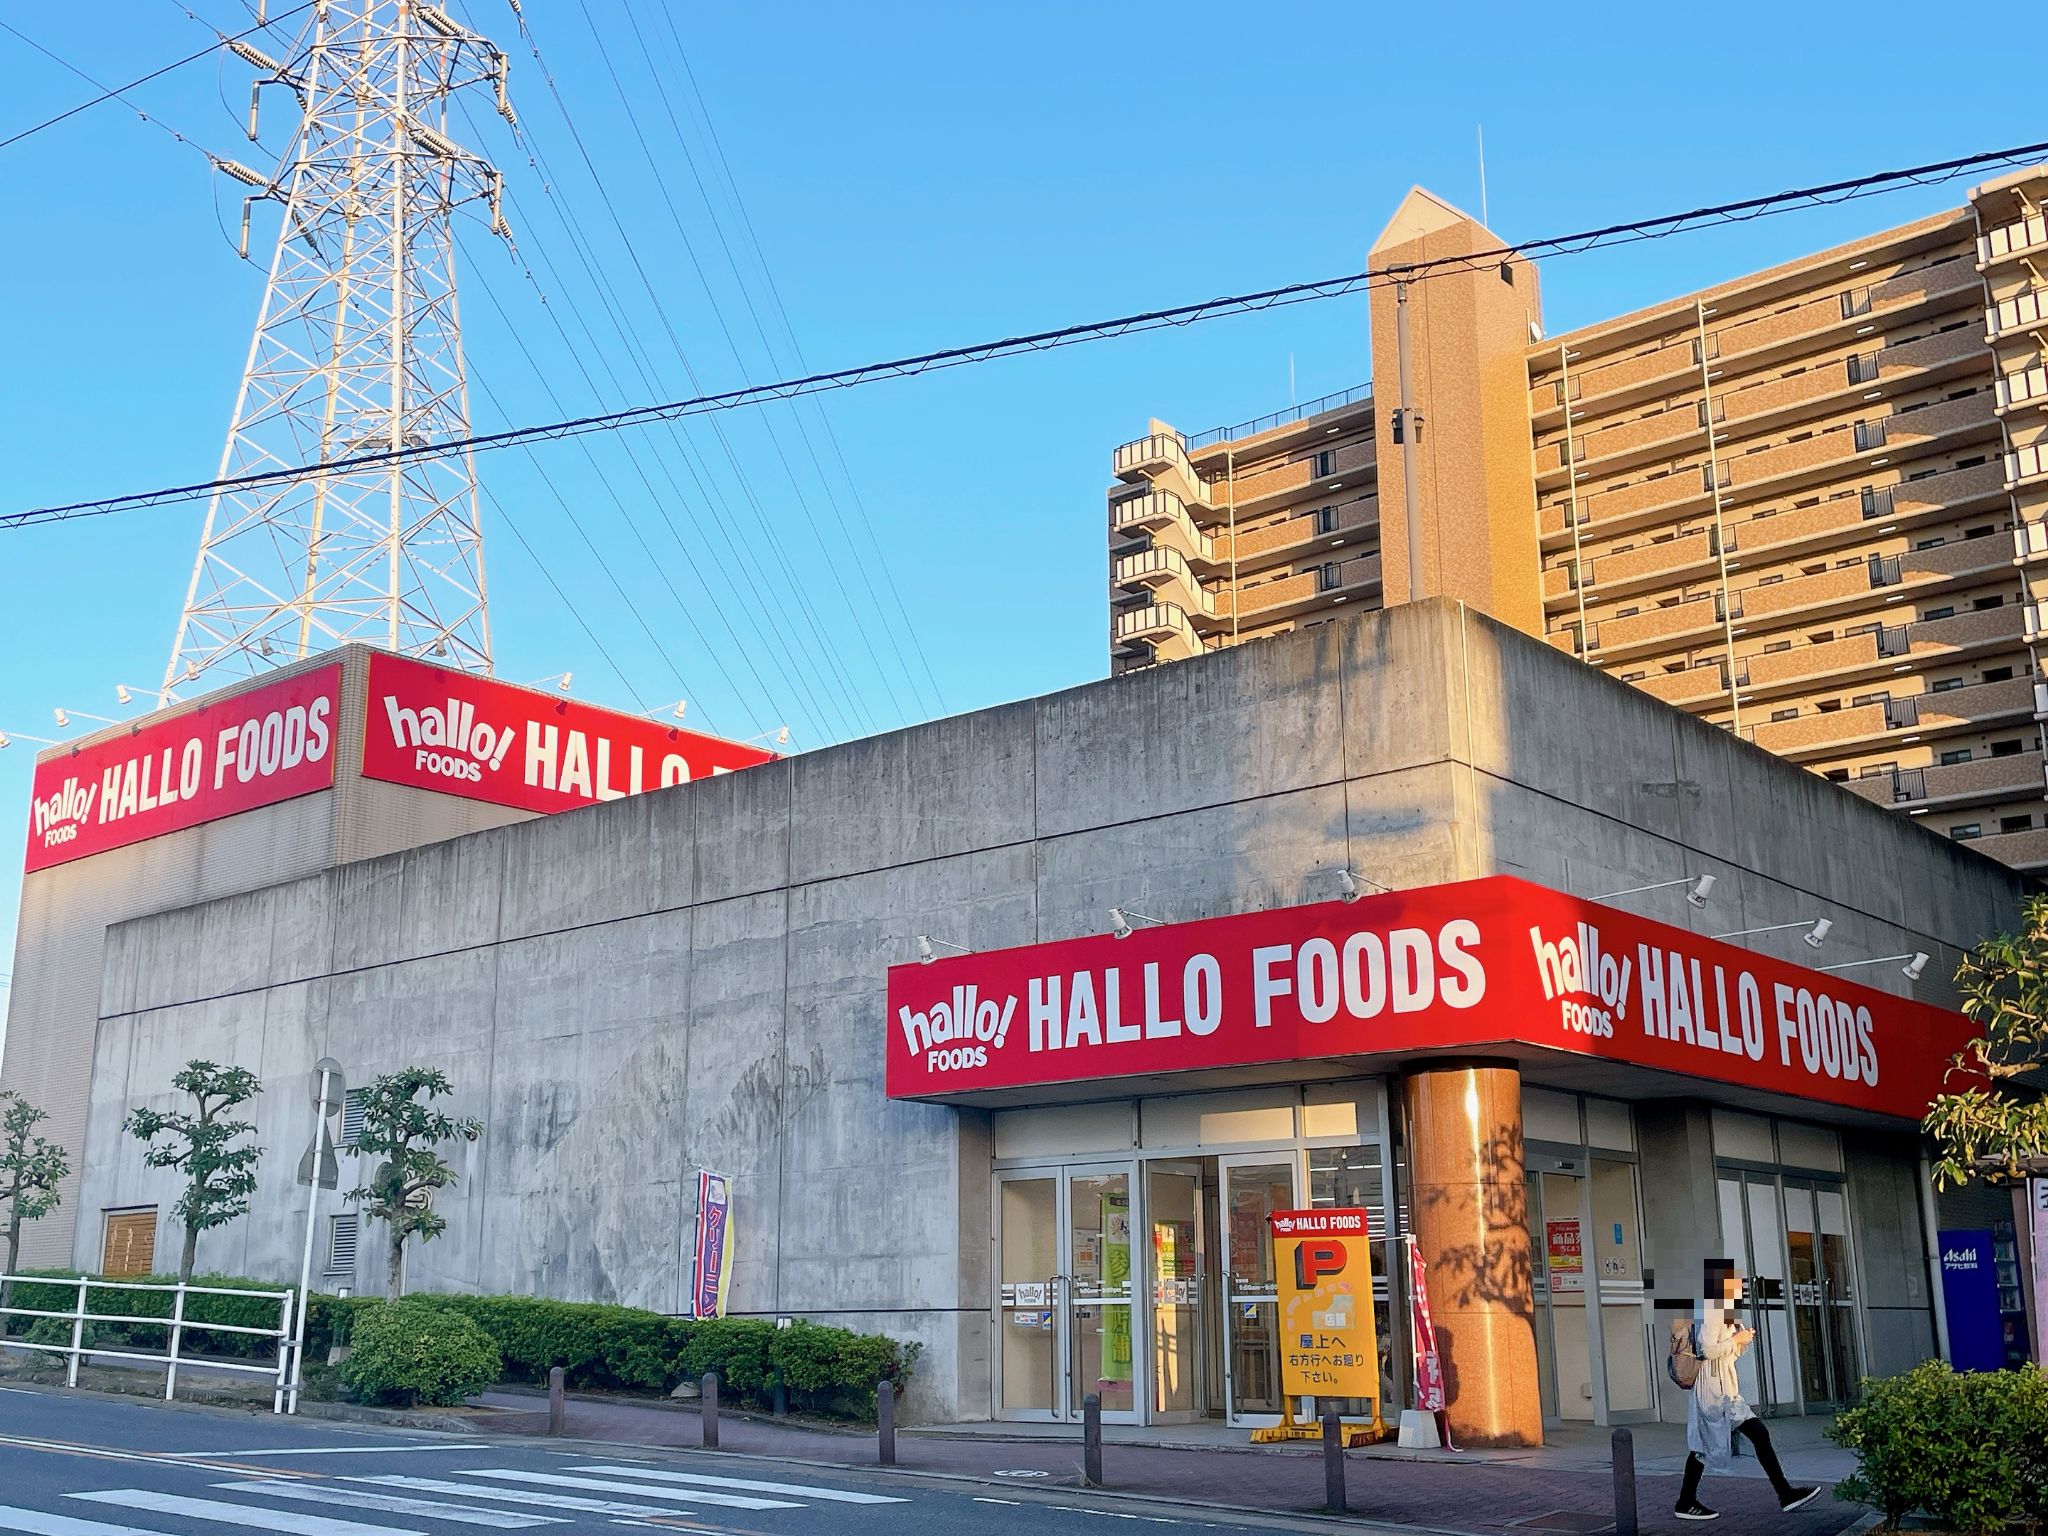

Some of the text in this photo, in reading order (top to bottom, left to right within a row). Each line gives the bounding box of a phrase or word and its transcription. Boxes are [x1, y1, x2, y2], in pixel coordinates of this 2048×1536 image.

[384, 695, 515, 772] hallo!
[99, 695, 330, 825] HALLO FOODS
[415, 751, 482, 782] FOODS
[34, 776, 98, 835] hallo!
[45, 823, 77, 848] FOODS
[1028, 919, 1487, 1053] HALLO FOODS
[1529, 921, 1633, 1021] hallo!
[898, 985, 1018, 1058] hallo!
[1562, 1000, 1614, 1039] FOODS
[1638, 943, 1879, 1087] HALLO FOODS
[927, 1046, 988, 1073] FOODS
[1296, 1216, 1327, 1230] HALLO
[1330, 1216, 1361, 1229] FOODS
[703, 1205, 723, 1317] クリーニン
[1295, 1239, 1348, 1290] P
[1943, 1248, 1977, 1262] Asahi
[1018, 1285, 1042, 1300] hallo!
[1300, 1333, 1346, 1349] 屋上へ
[1301, 1370, 1338, 1384] 下さい。
